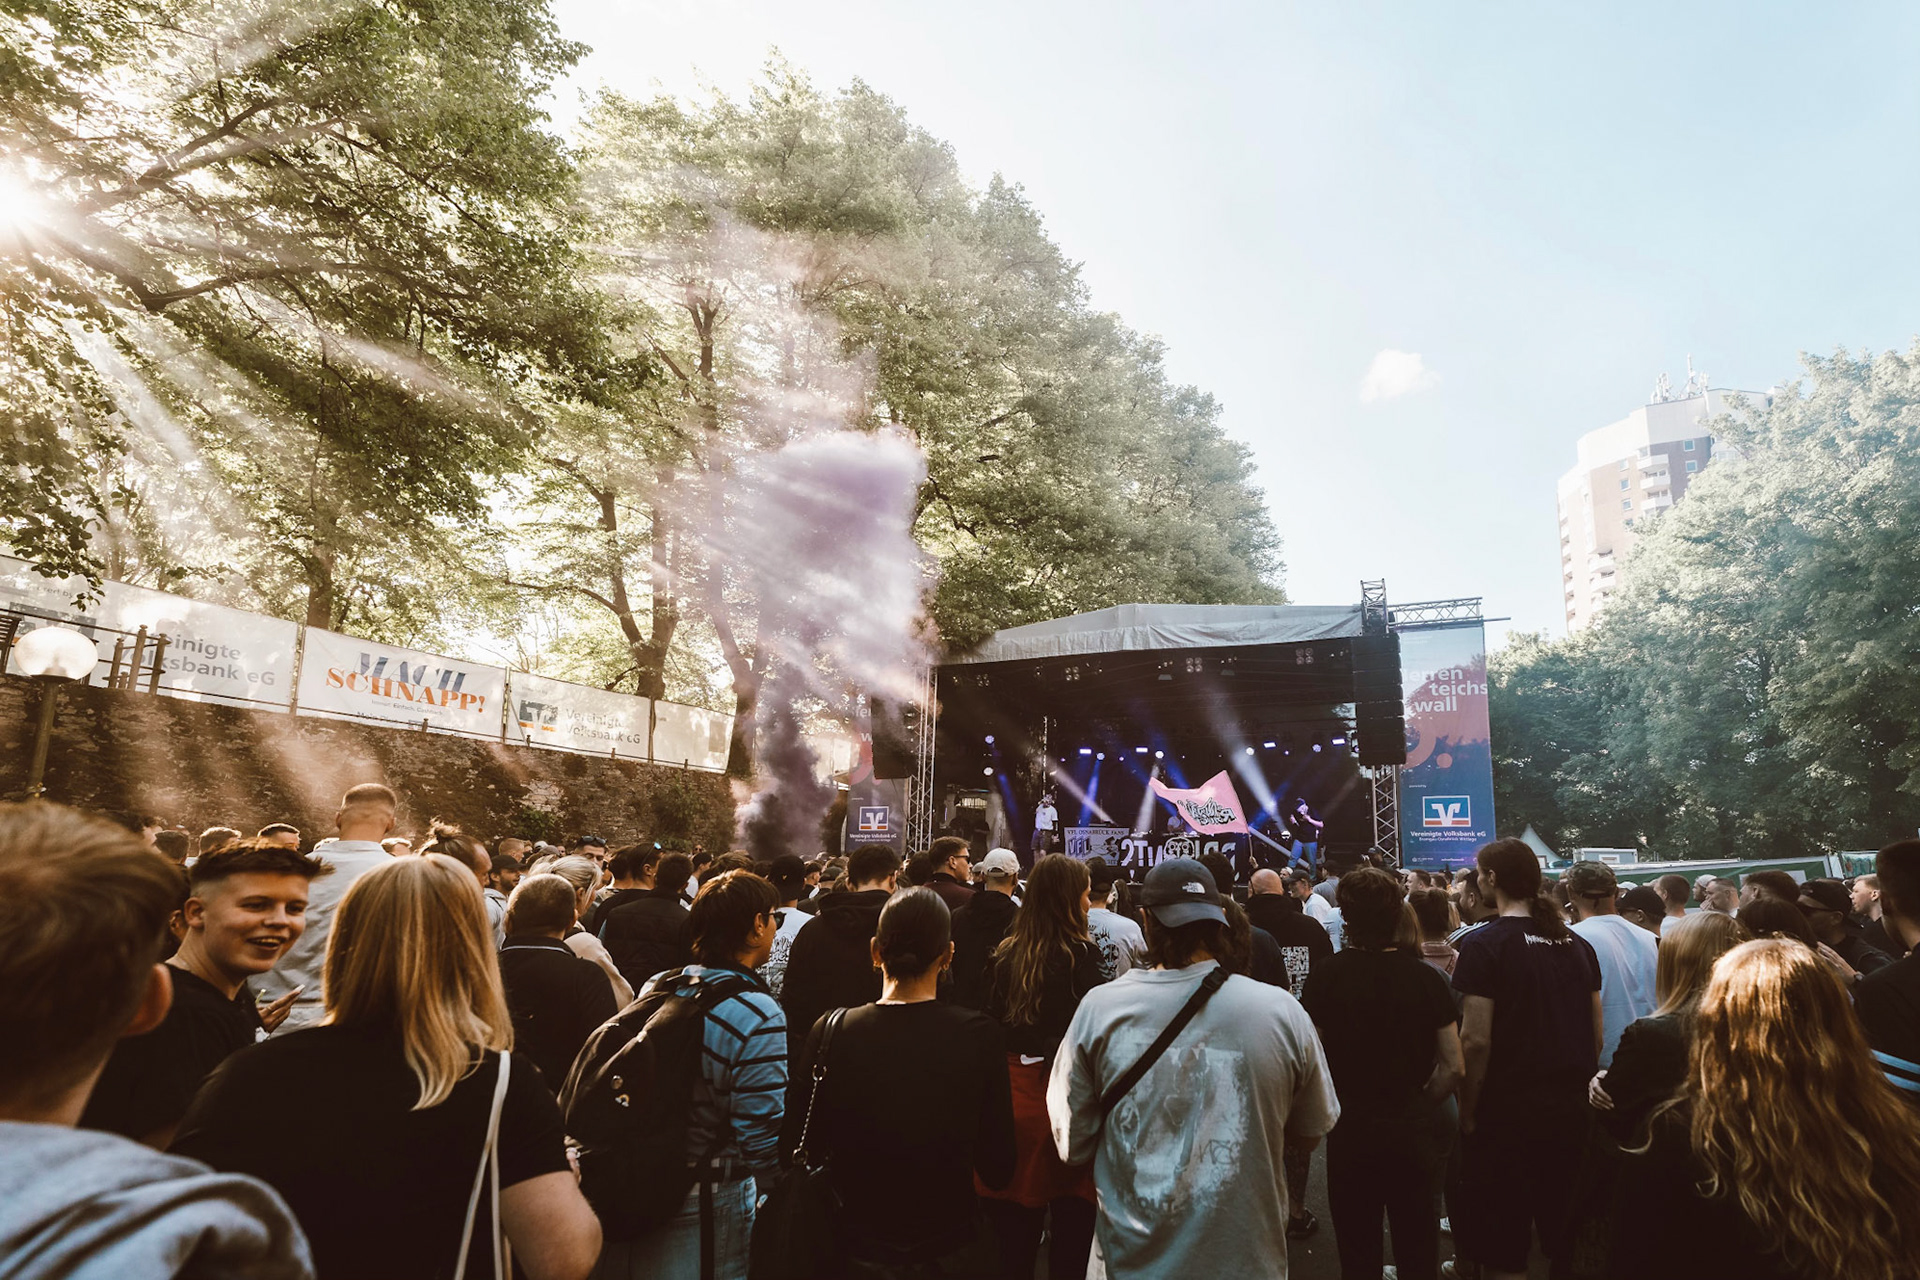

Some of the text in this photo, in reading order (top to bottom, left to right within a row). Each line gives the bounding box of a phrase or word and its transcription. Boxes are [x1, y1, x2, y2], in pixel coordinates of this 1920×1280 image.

[246, 670, 276, 686] eG
[353, 652, 469, 692] MACH
[325, 667, 486, 713] SCHNAPP!
[1428, 680, 1488, 696] teichs
[1413, 696, 1457, 713] wall
[1410, 830, 1442, 838] Vereinigte
[1068, 836, 1091, 858] VFL
